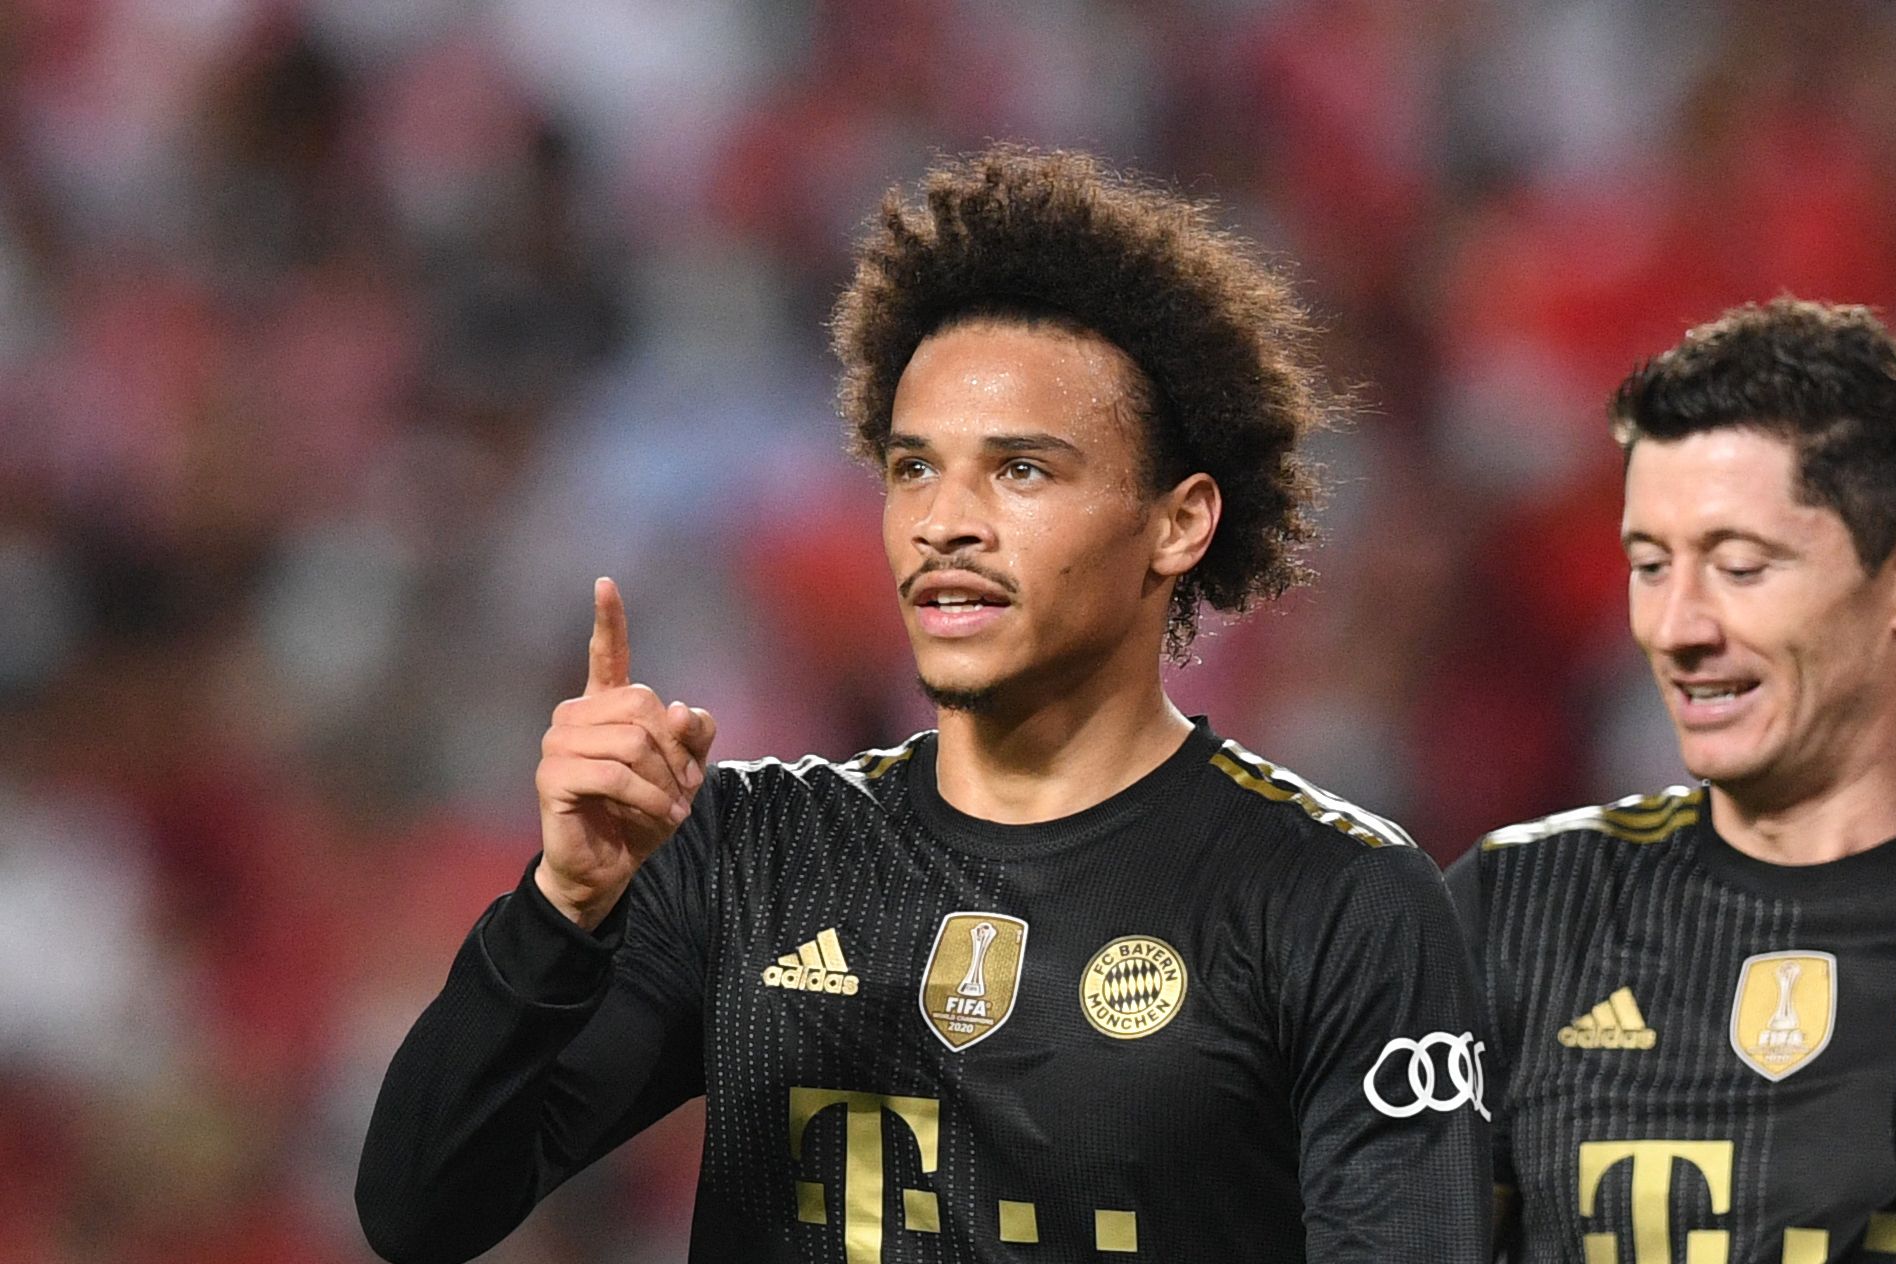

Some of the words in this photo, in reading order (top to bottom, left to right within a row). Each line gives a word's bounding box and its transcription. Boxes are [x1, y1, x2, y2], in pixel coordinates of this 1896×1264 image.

[1094, 953, 1115, 976] FC
[1119, 943, 1178, 982] BAYERN
[762, 965, 860, 996] adidas
[945, 996, 987, 1017] FIFA
[947, 1021, 975, 1034] 2020
[1557, 1026, 1657, 1050] adidas
